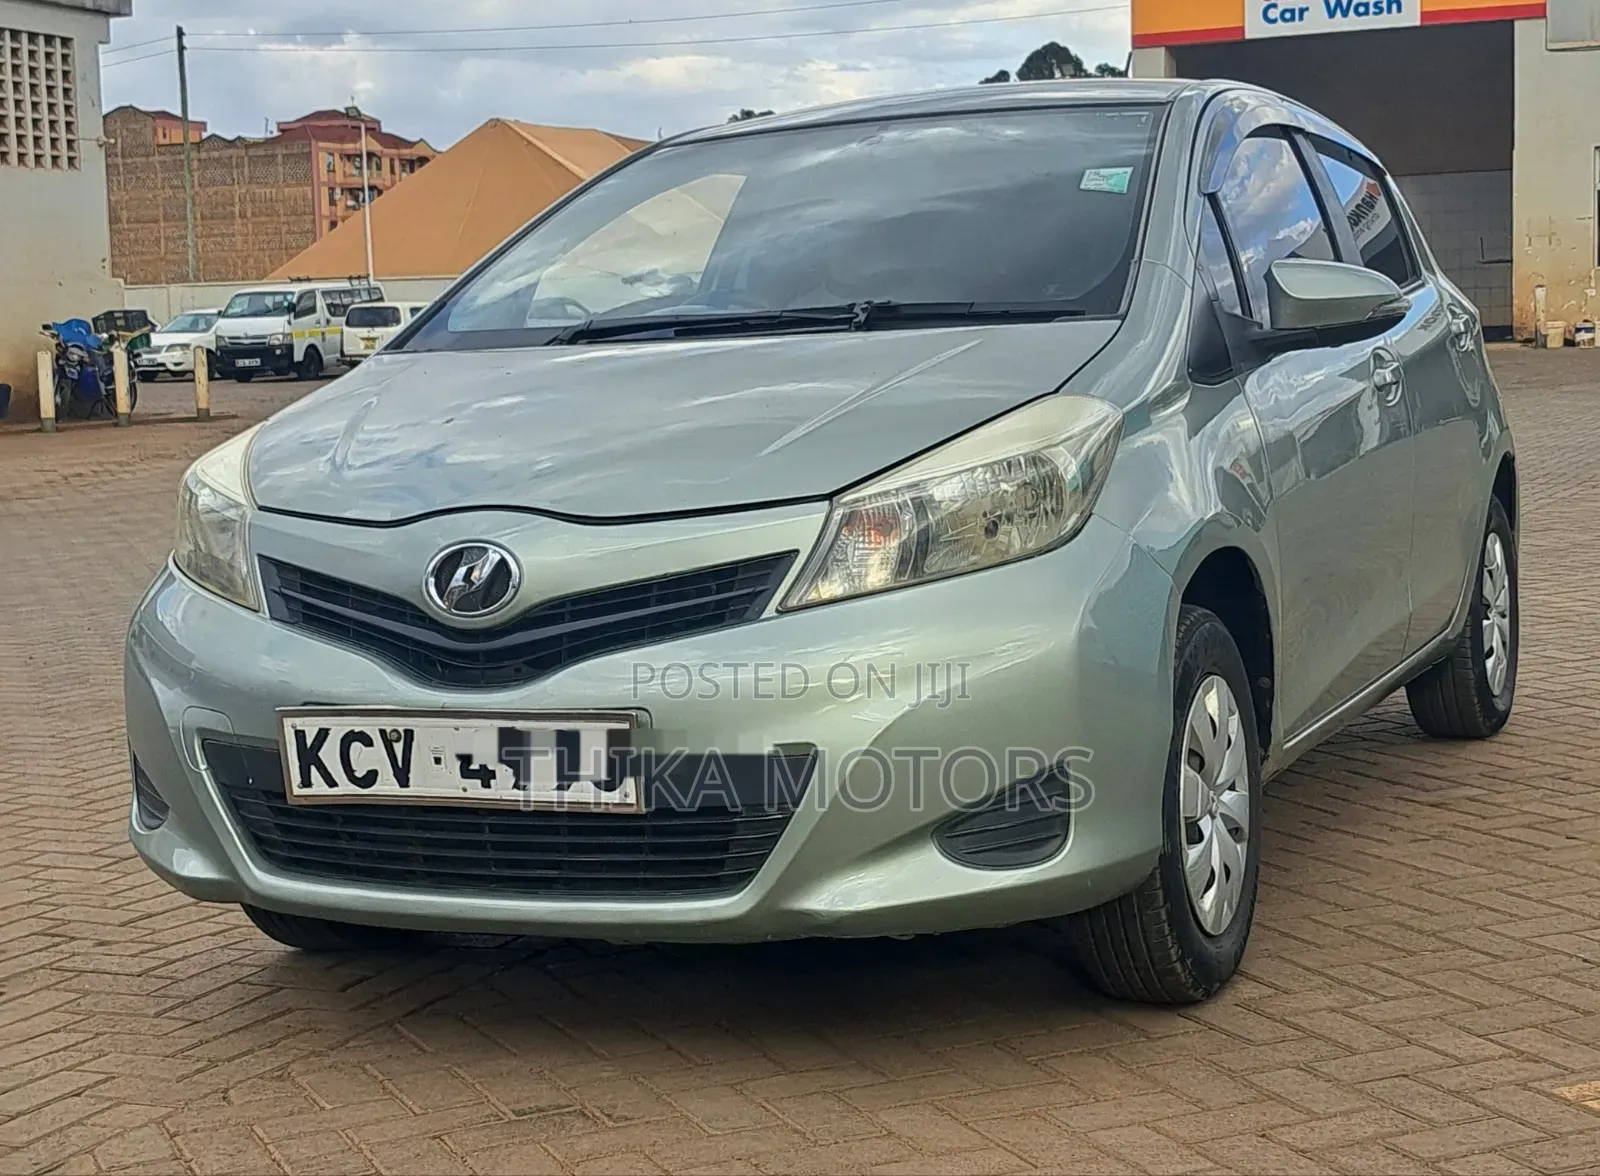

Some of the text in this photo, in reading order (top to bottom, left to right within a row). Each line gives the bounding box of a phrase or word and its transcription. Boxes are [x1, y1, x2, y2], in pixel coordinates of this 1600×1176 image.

[1262, 0, 1402, 24] Car Wash
[294, 727, 415, 790] KCV
